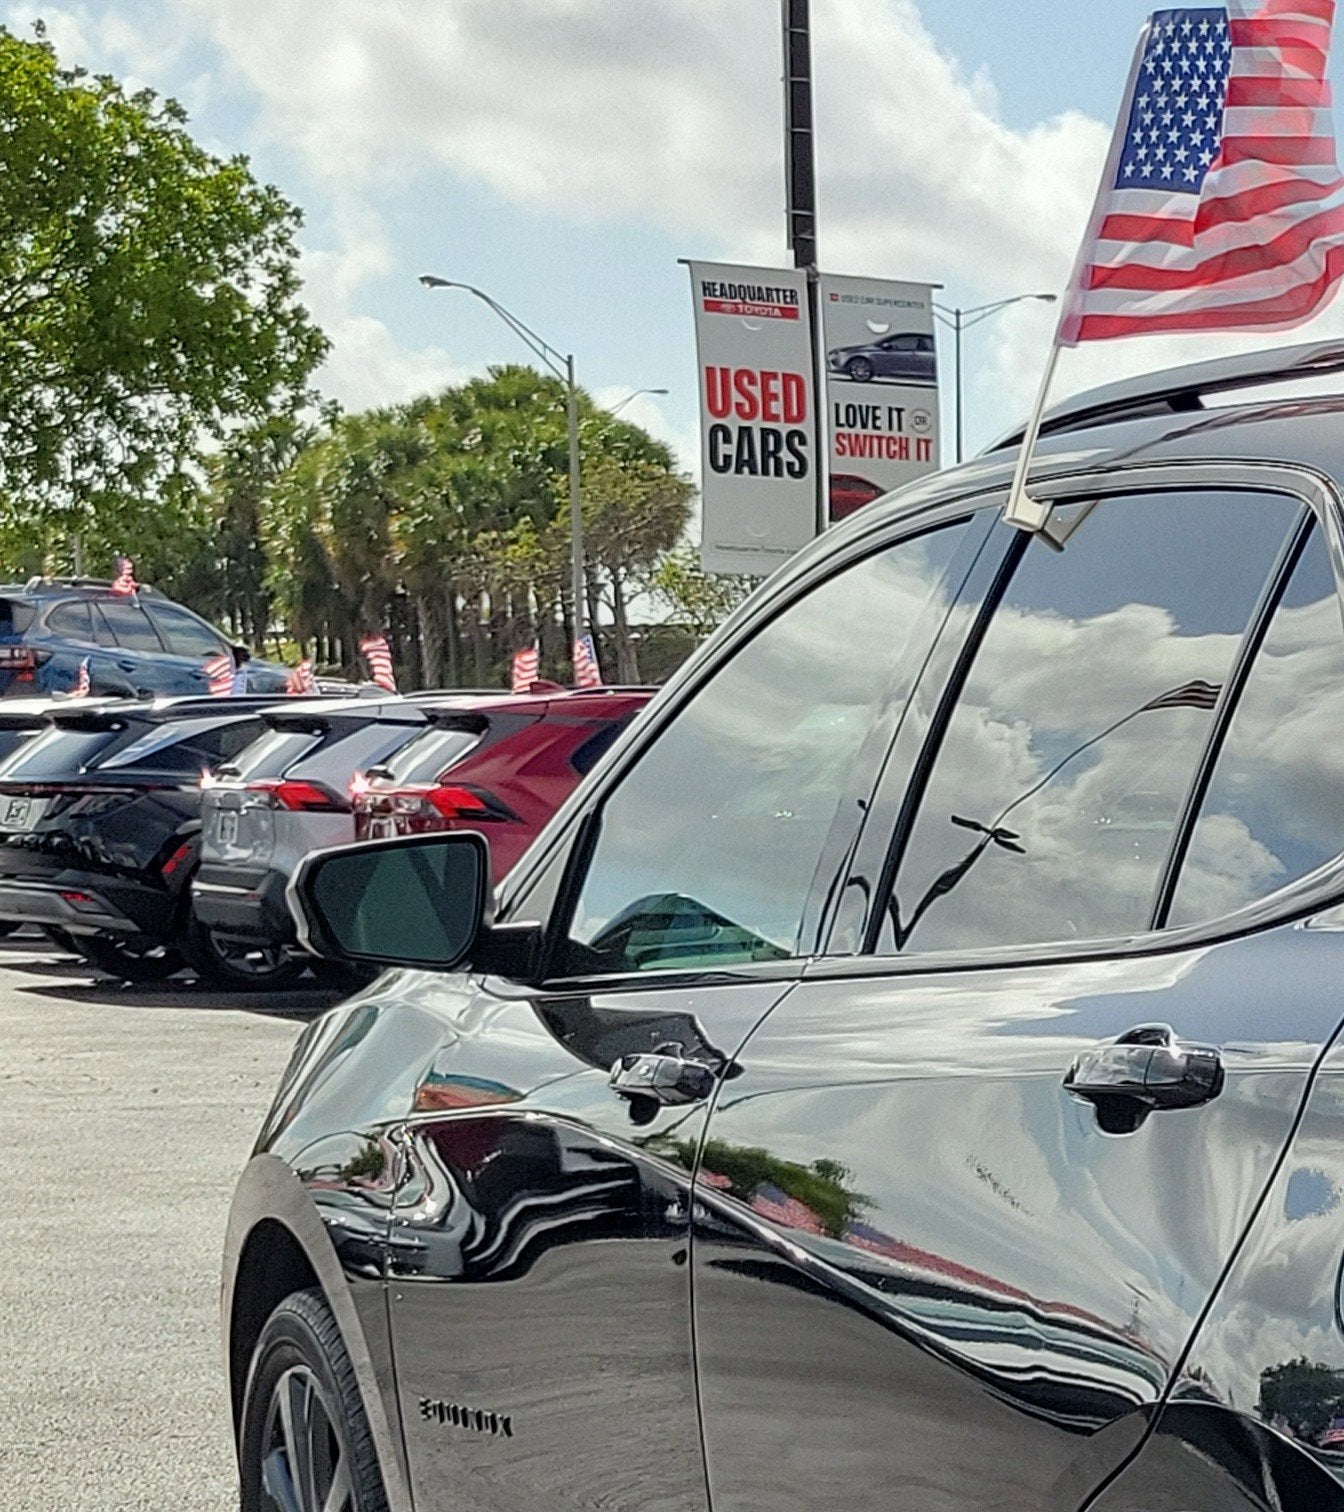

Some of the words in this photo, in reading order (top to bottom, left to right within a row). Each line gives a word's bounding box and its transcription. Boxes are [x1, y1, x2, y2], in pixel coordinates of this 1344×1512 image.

[702, 281, 799, 306] HEADQUARTER
[737, 304, 782, 317] TOYOTA
[705, 366, 807, 425] USED
[834, 402, 882, 431] LOVE
[887, 406, 905, 432] IT
[709, 424, 809, 479] CARS
[835, 432, 910, 461] SWITCH
[916, 438, 933, 462] IT
[419, 1397, 514, 1437] EQUINOX
